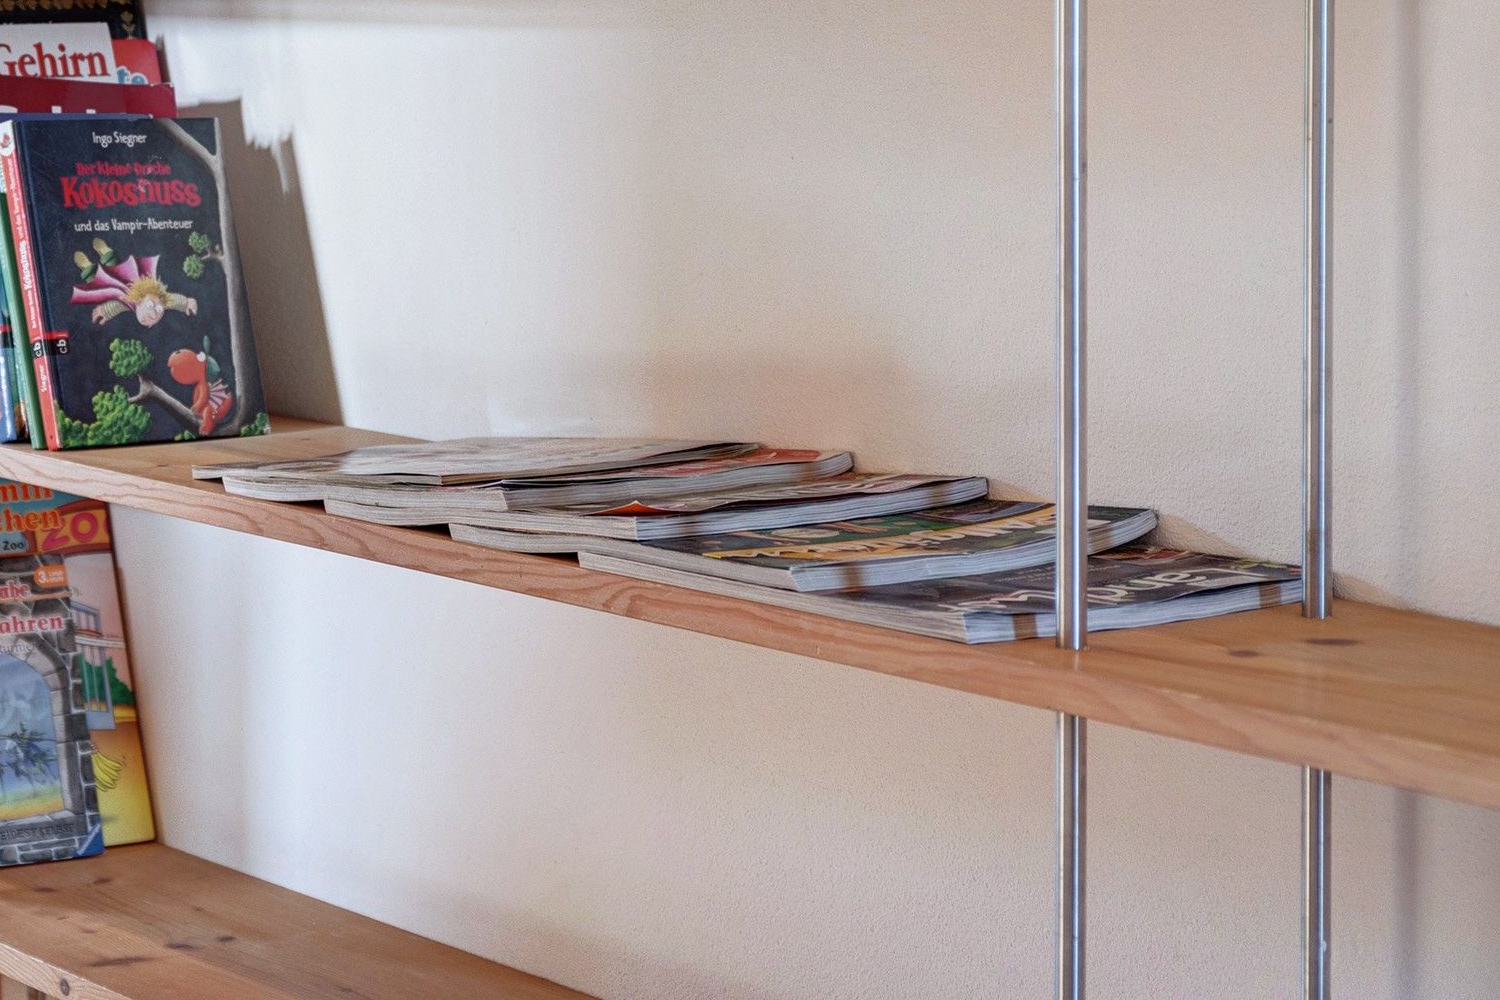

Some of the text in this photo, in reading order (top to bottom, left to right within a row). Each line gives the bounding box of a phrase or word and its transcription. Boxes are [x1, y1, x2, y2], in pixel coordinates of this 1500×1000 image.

[92, 130, 148, 148] Ingo Siegner
[75, 161, 96, 176] Der
[74, 217, 194, 235] und das Vampir-Abenteuer
[41, 511, 111, 550] ZO
[2, 539, 26, 552] Zoo
